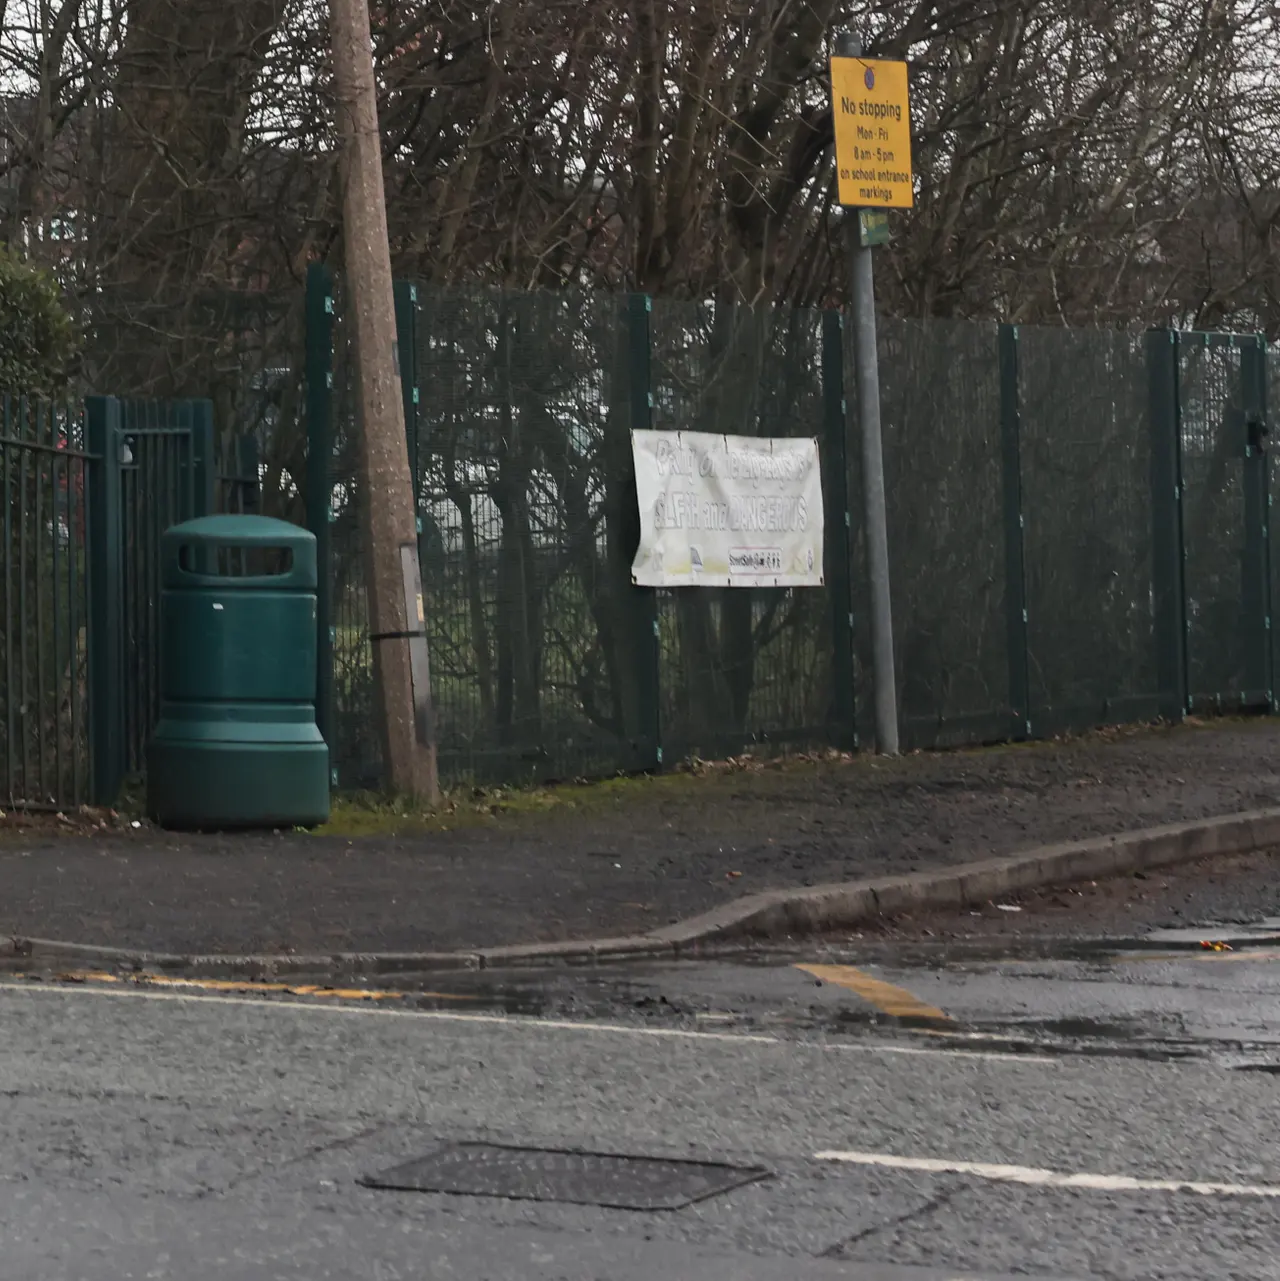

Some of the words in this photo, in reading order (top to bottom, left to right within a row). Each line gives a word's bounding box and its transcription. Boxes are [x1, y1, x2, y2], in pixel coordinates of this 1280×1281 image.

[841, 96, 856, 115] No
[859, 99, 901, 122] stopping
[857, 125, 873, 140] Mon
[878, 127, 889, 141] Fri
[840, 170, 850, 180] on
[852, 168, 876, 181] school
[878, 170, 909, 183] entrance
[859, 187, 892, 202] markings
